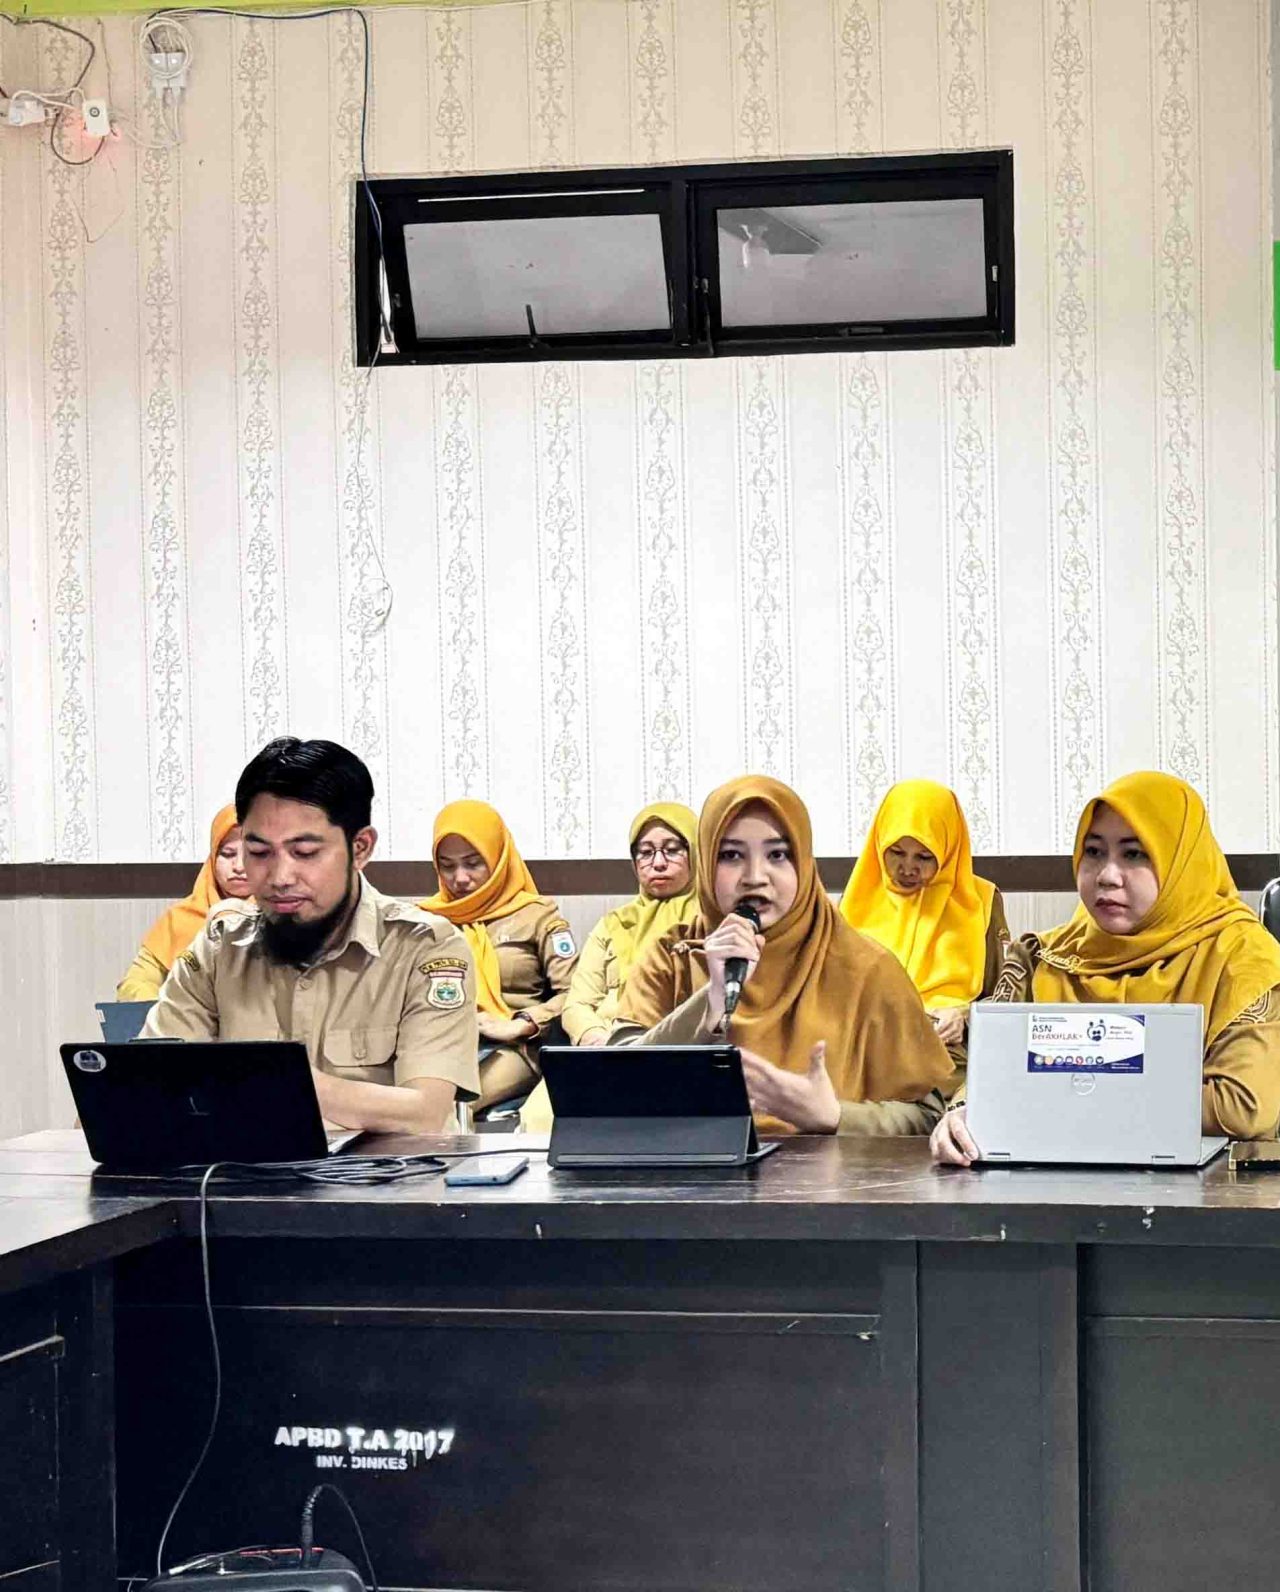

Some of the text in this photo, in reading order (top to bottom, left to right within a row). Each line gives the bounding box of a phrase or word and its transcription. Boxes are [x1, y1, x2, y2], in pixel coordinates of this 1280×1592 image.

[1032, 1024, 1053, 1033] ASN
[274, 1426, 343, 1448] APBD
[394, 1428, 455, 1459] 2017
[316, 1455, 409, 1471] INV. DINKES
